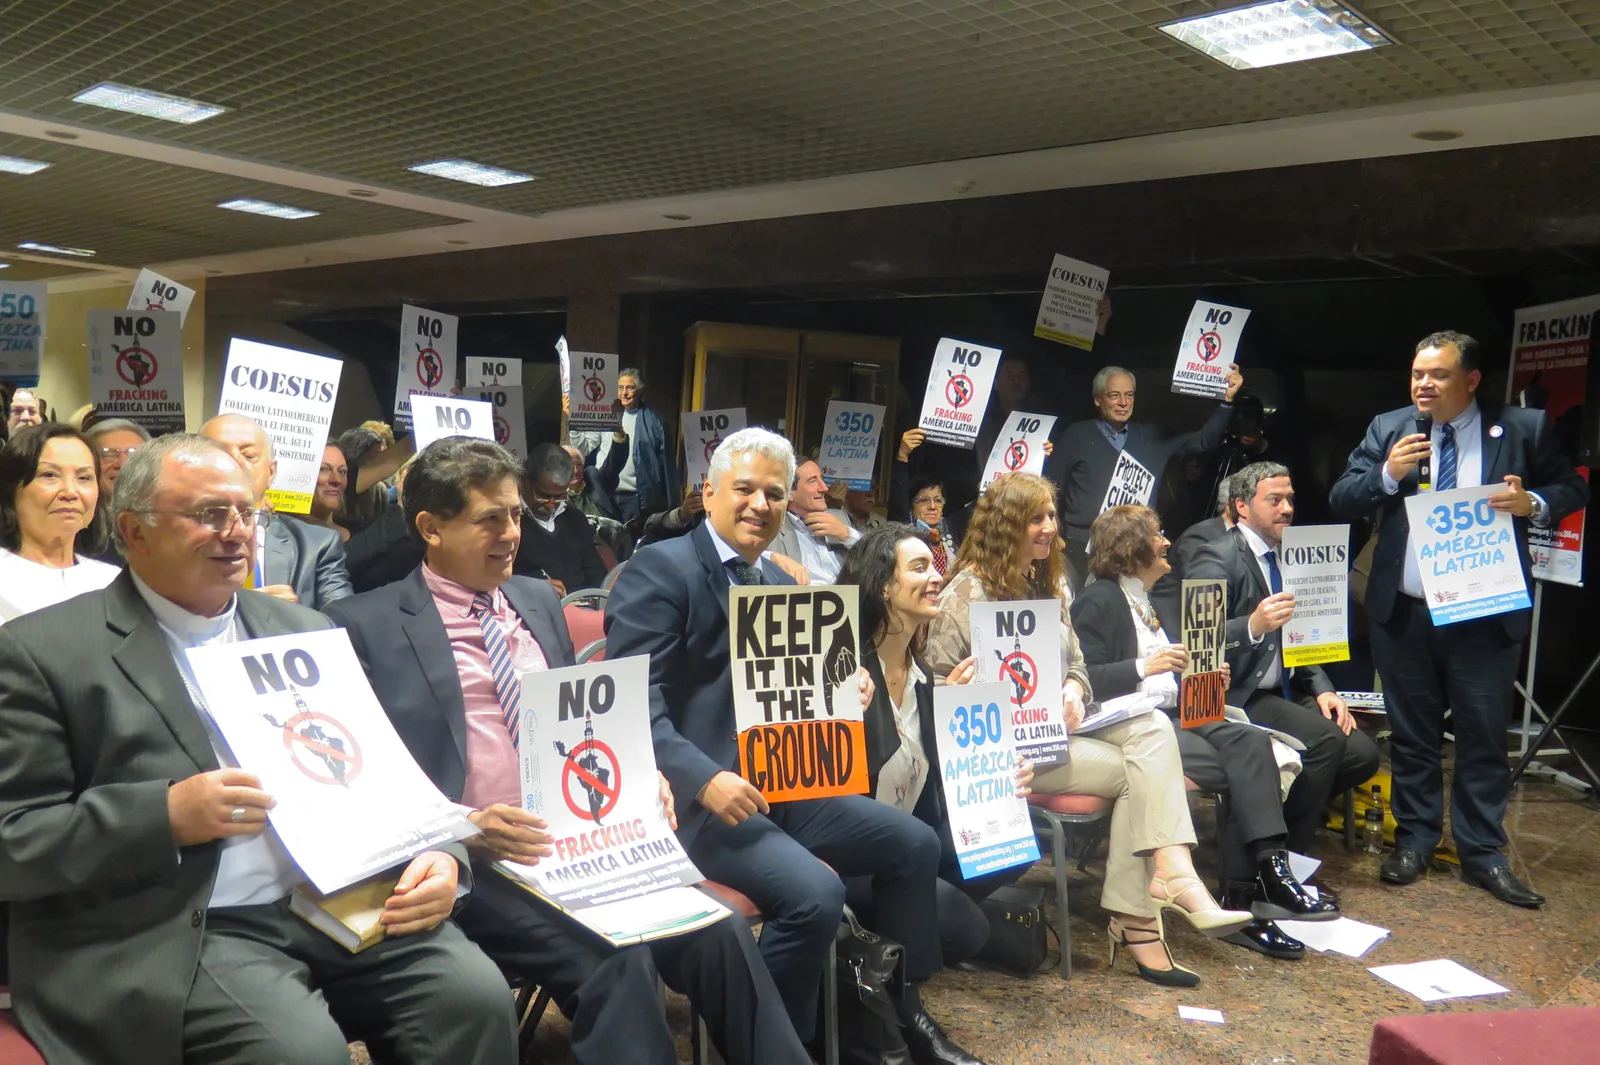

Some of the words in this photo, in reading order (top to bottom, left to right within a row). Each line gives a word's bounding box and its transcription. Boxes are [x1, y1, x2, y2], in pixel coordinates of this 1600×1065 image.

[151, 280, 178, 301] NO
[1052, 267, 1105, 292] COESUS
[114, 316, 156, 337] NO
[417, 315, 443, 339] NO
[1205, 307, 1232, 325] NO
[583, 357, 605, 371] NO
[952, 346, 982, 367] NO
[1186, 361, 1222, 374] FRACKING
[482, 362, 507, 376] NO
[109, 389, 168, 401] FRACKING
[231, 365, 334, 403] COESUS
[147, 402, 182, 411] LATINA
[267, 406, 329, 425] LATINOAMERICANA
[435, 405, 472, 430] NO
[578, 403, 608, 412] FRACKING
[597, 412, 618, 420] LATINA
[934, 407, 973, 422] FRACKING
[269, 421, 278, 430] EL
[700, 414, 729, 431] NO
[838, 411, 875, 434] 350
[954, 422, 978, 434] LATINA
[1016, 417, 1041, 433] NO
[824, 432, 877, 447] AMÉRICA
[279, 449, 316, 462] SOSTENIBLE
[827, 447, 869, 459] LATINA
[1116, 456, 1152, 495] PROTECT
[1433, 498, 1495, 534] 350
[1285, 544, 1346, 566] COESUS
[1420, 528, 1511, 560] AMÉRICA
[1433, 548, 1505, 577] LATINA
[1185, 583, 1223, 630] KEEP
[737, 590, 845, 659] KEEP
[996, 609, 1036, 638] NO
[1188, 630, 1200, 651] IT
[1203, 629, 1214, 650] IN
[241, 648, 320, 695] NO
[744, 658, 775, 690] IT
[784, 657, 815, 688] IN
[1191, 651, 1213, 674] THE
[558, 674, 615, 722] NO
[755, 689, 815, 722] THE
[1184, 671, 1222, 722] GROUND
[954, 702, 1001, 748] 350
[1029, 723, 1064, 741] LATINA
[746, 722, 853, 793] GROUND
[1042, 743, 1067, 753] www.350.org
[945, 745, 1016, 781] AMÉRICA
[527, 793, 535, 810] 350
[957, 775, 1014, 808] LATINA
[555, 818, 647, 862] FRACKING
[620, 837, 679, 866] LATINA
